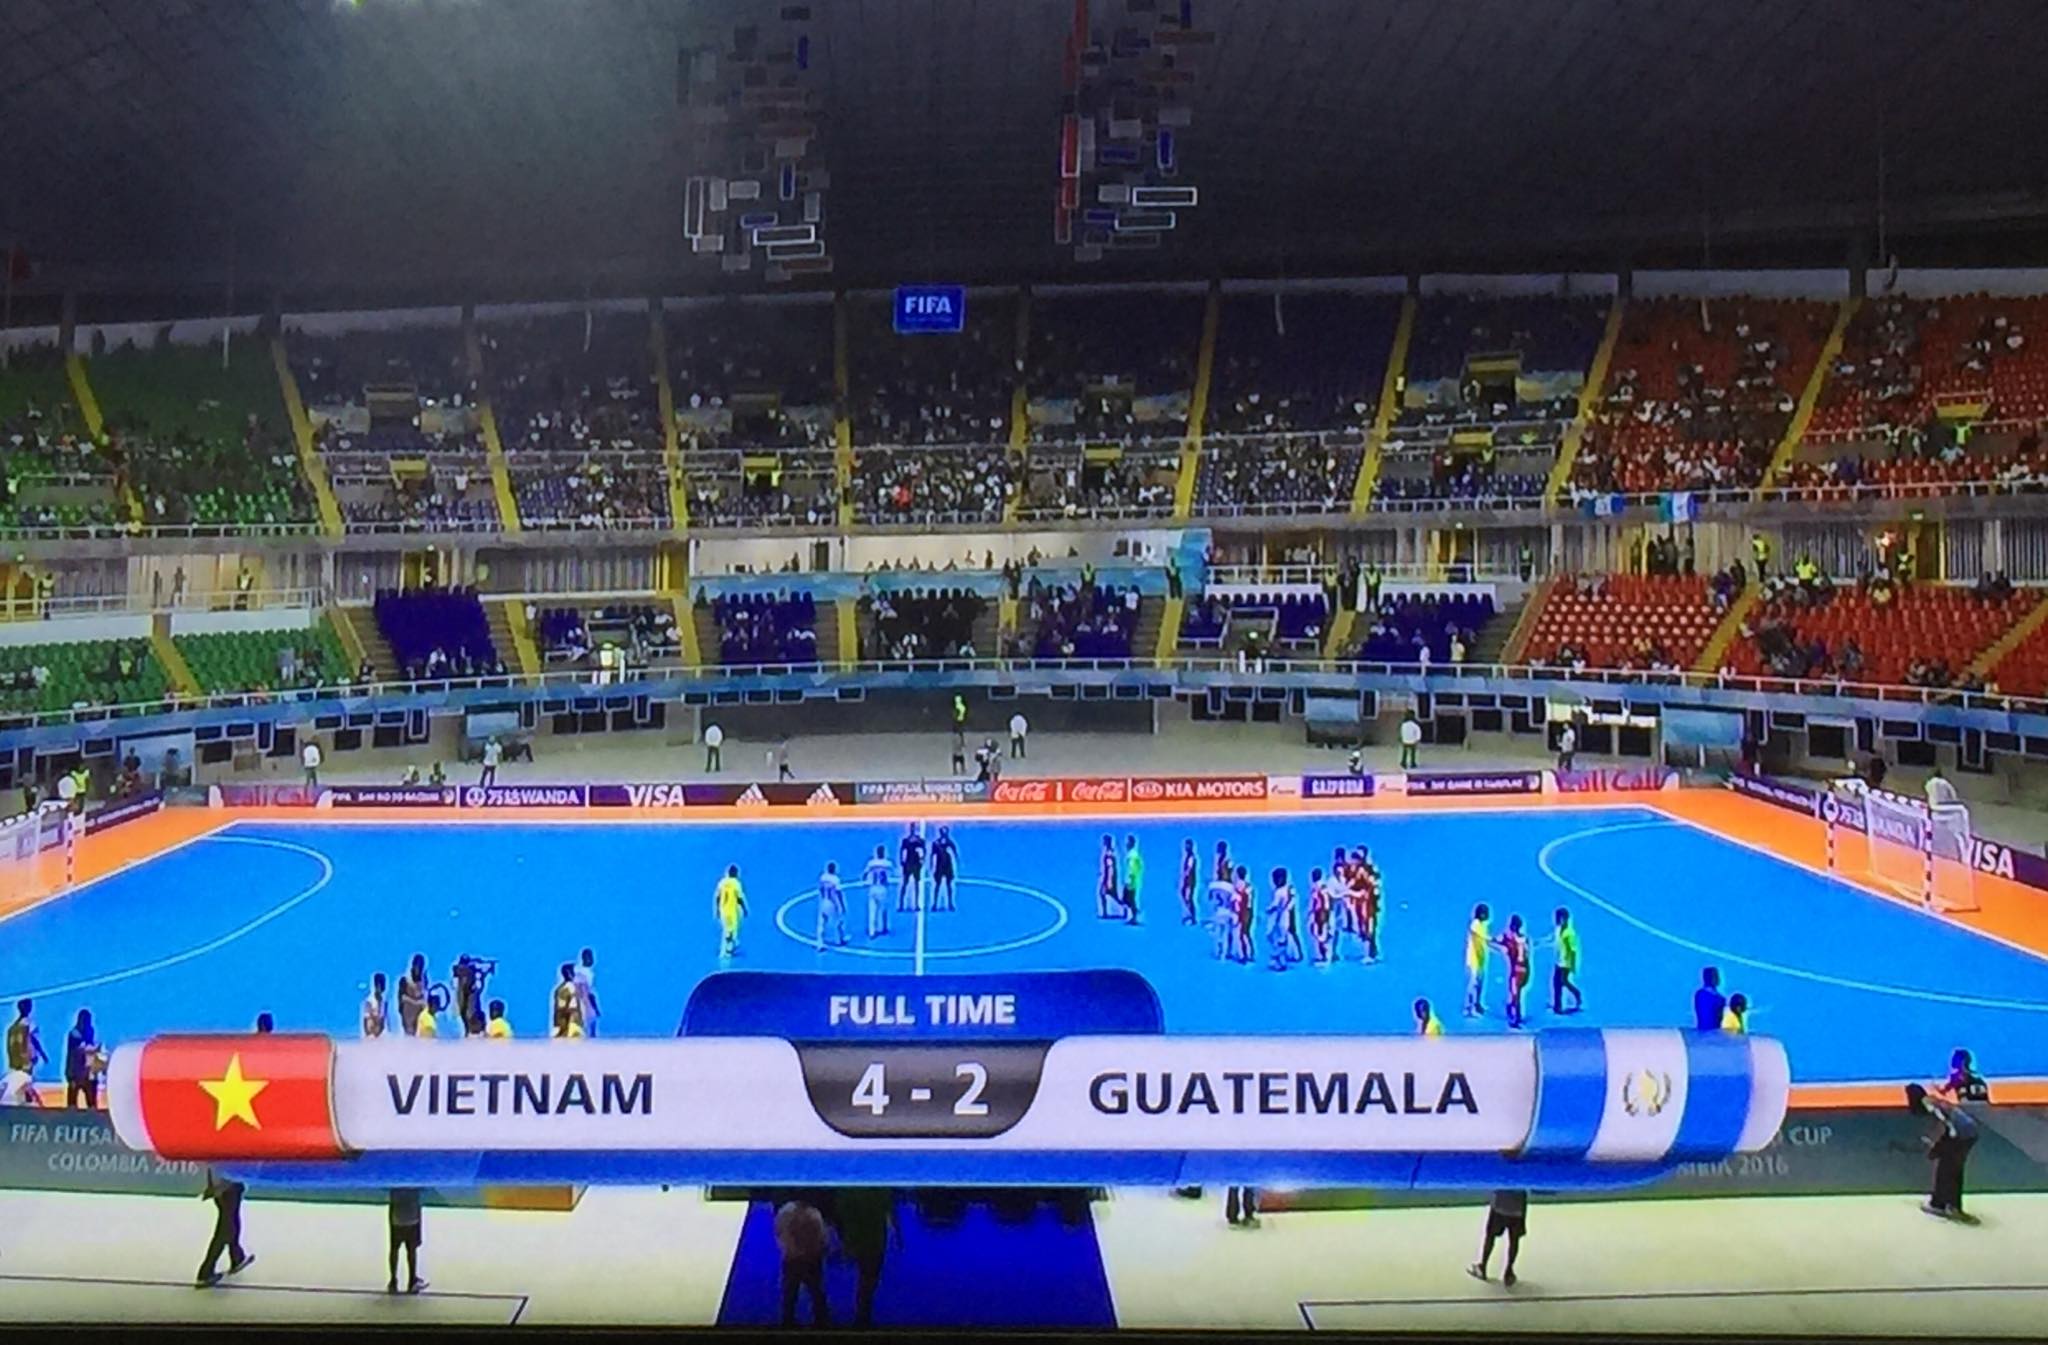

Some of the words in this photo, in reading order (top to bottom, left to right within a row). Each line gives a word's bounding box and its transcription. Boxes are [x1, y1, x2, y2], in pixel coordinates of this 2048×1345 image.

[905, 296, 952, 314] FIFA
[520, 788, 579, 804] WANDA
[623, 784, 685, 806] VISA
[1165, 782, 1193, 797] KIA
[1196, 781, 1265, 797] MOTORS
[830, 995, 916, 1026] FULL
[925, 994, 1016, 1025] TIME
[386, 1073, 653, 1115] VIETNAM
[852, 1063, 890, 1115] 4
[954, 1062, 988, 1115] 2
[1089, 1072, 1479, 1114] GUATEMALA
[11, 1124, 49, 1144] FIFA
[1788, 1126, 1832, 1146] CUP
[48, 1151, 150, 1174] COLOMBIA
[1738, 1154, 1789, 1177] 2016
